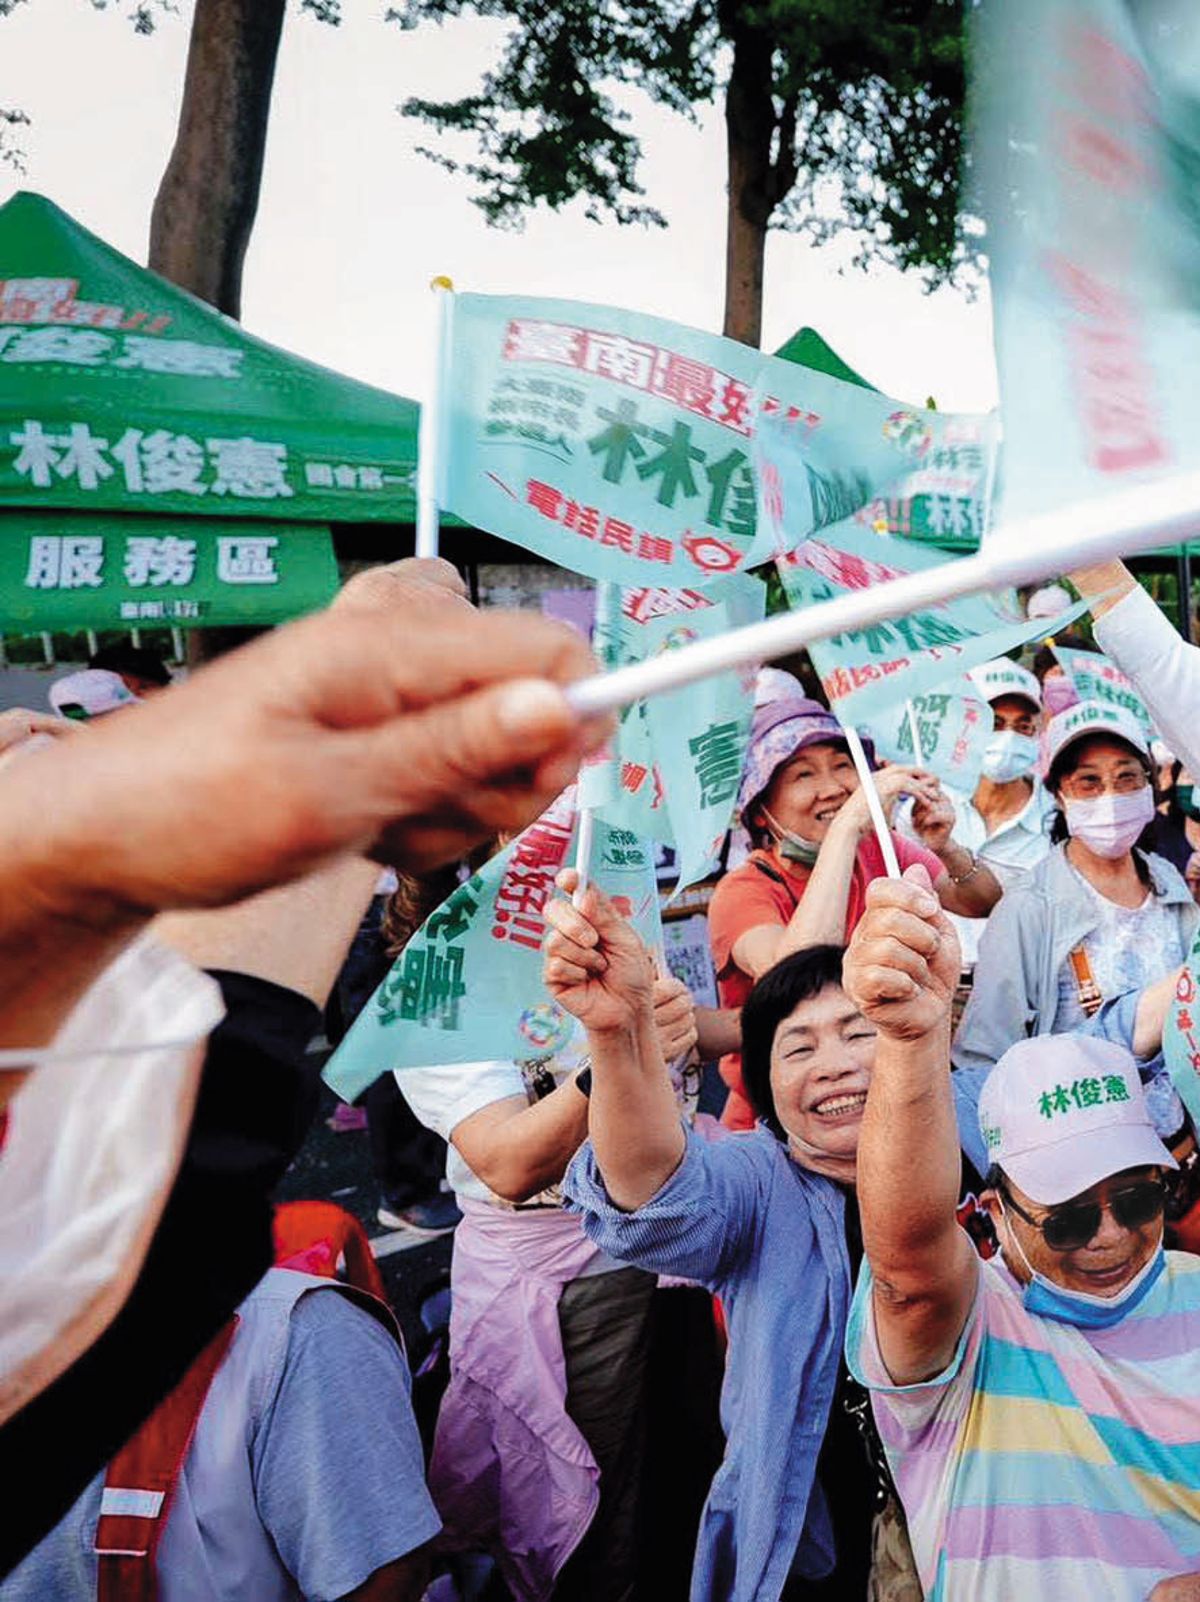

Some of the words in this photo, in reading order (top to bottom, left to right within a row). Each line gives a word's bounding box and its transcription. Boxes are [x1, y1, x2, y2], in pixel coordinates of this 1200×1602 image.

[10, 420, 293, 498] 林俊憲
[527, 477, 674, 565] 電話民調
[25, 535, 279, 589] 服務區
[1038, 1074, 1131, 1119] 林俊憲
